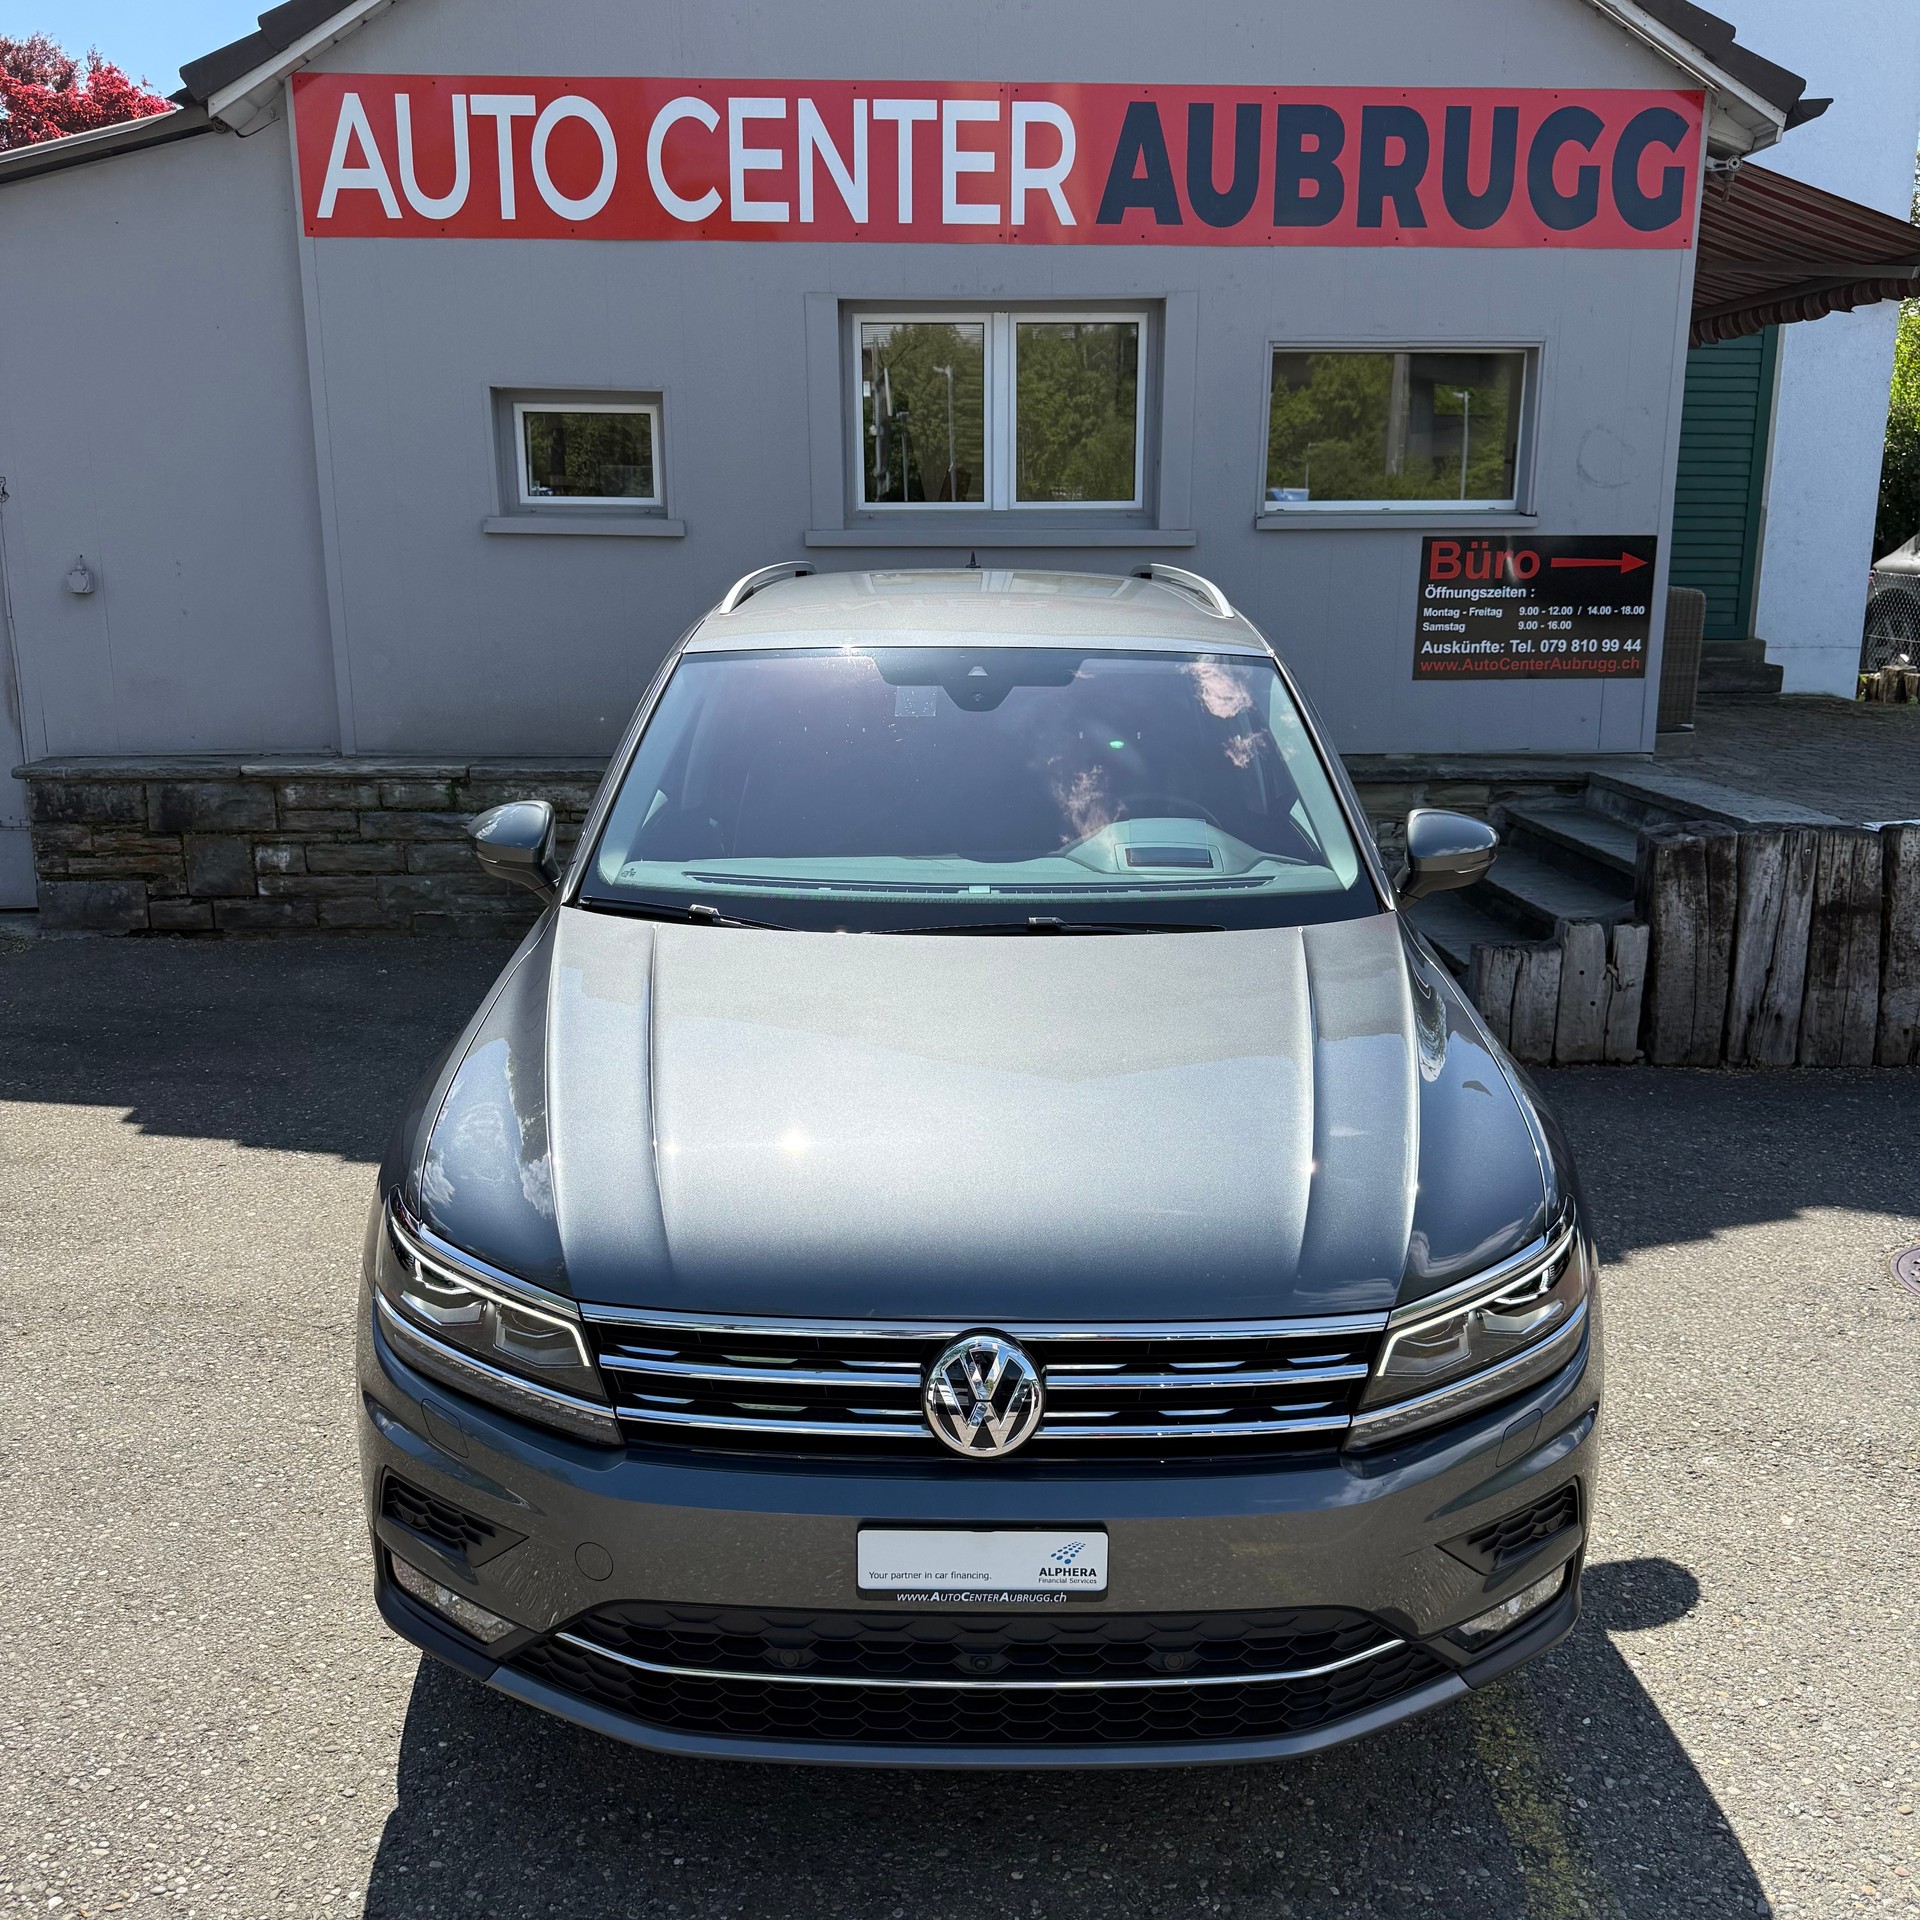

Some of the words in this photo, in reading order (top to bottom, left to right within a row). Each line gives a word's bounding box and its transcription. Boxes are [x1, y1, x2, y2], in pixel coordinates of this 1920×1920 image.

[317, 92, 618, 221] AUTO
[646, 96, 1077, 227] CENTER
[1095, 100, 1690, 232] AUBRUGG
[1428, 541, 1541, 580] Büro
[1424, 585, 1527, 601] Öffnungszeiten
[1423, 607, 1460, 618] Montag
[1469, 607, 1503, 617] Freitag
[1519, 607, 1539, 615] 9.00
[1548, 606, 1573, 615] 12.00
[1587, 606, 1611, 615] 14.00
[1620, 606, 1645, 614] 18.00
[1422, 623, 1466, 632] Samstag
[1517, 622, 1538, 630] 9.00
[1547, 621, 1572, 630] 16.00
[1421, 640, 1505, 655] Auskünfte:
[1510, 640, 1535, 653] Tel.
[1540, 640, 1567, 653] 079
[1570, 640, 1597, 652] 810
[1601, 639, 1619, 652] 99
[1623, 639, 1641, 652] 44
[1420, 657, 1640, 673] www.AutoCenterAubrugg.ch
[869, 1571, 888, 1579] Your
[890, 1572, 922, 1581] partner
[950, 1571, 992, 1581] financing.
[1038, 1568, 1097, 1577] ALPHERA
